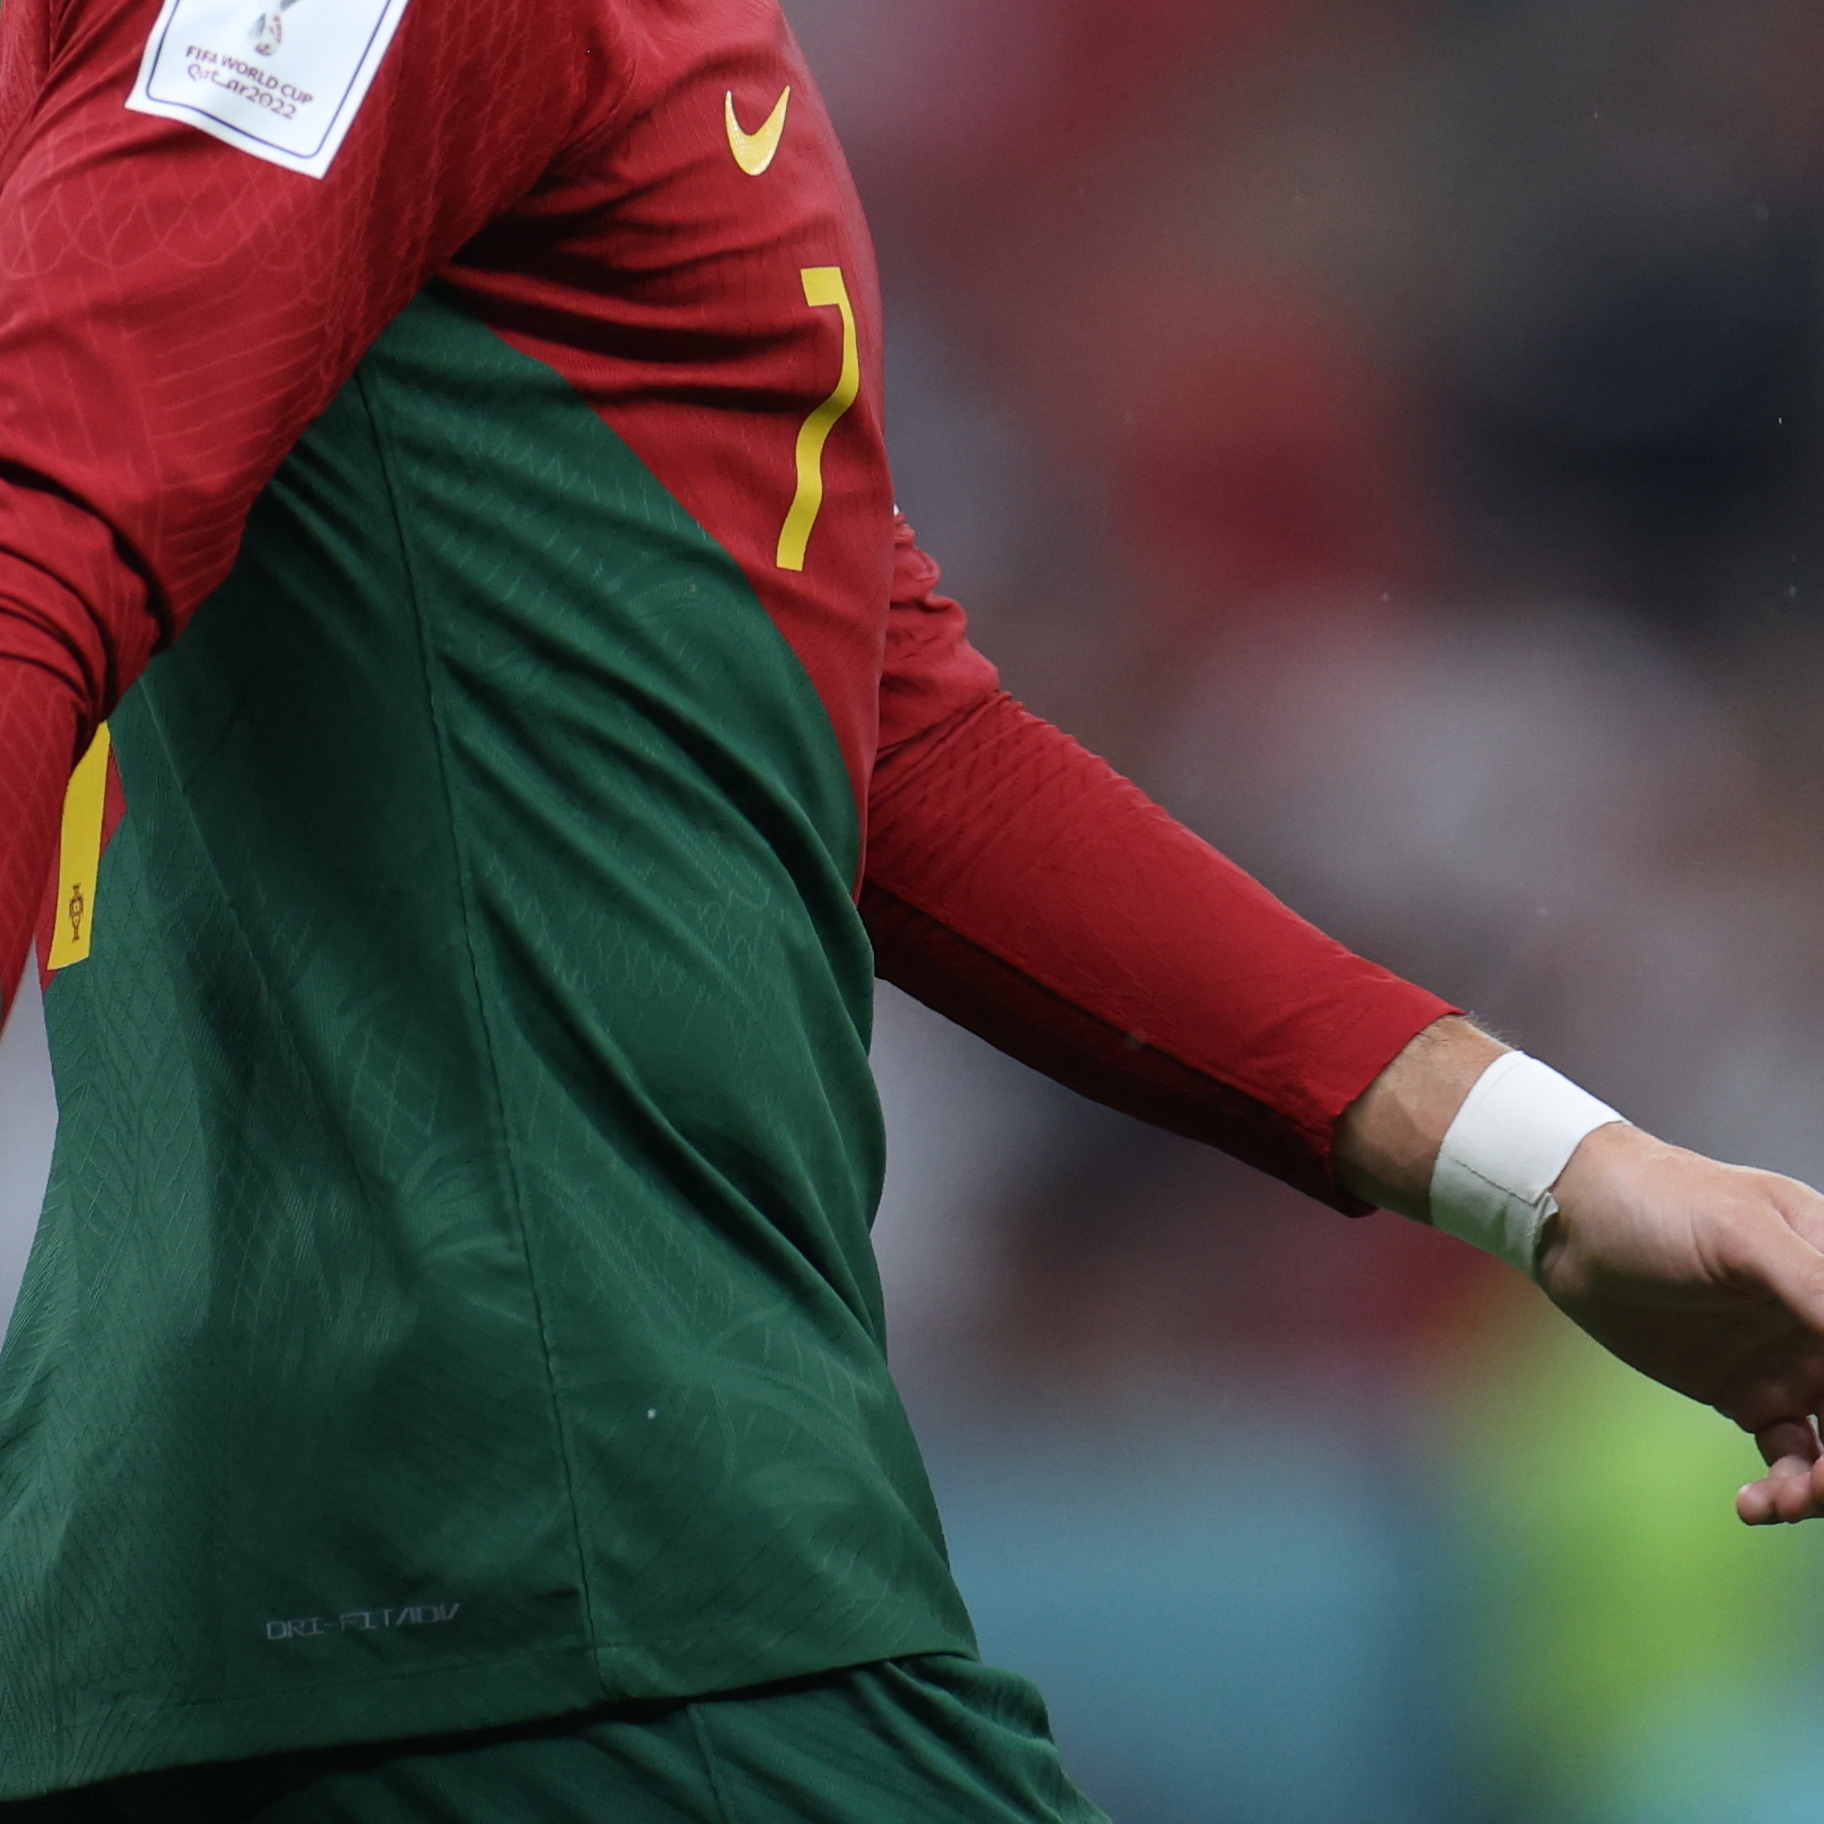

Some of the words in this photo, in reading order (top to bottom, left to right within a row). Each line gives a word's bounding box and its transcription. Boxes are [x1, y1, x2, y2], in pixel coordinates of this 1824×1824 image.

[186, 45, 218, 63] FIFA
[222, 56, 278, 90] WORLD
[280, 83, 314, 105] CUP
[777, 266, 859, 572] 7
